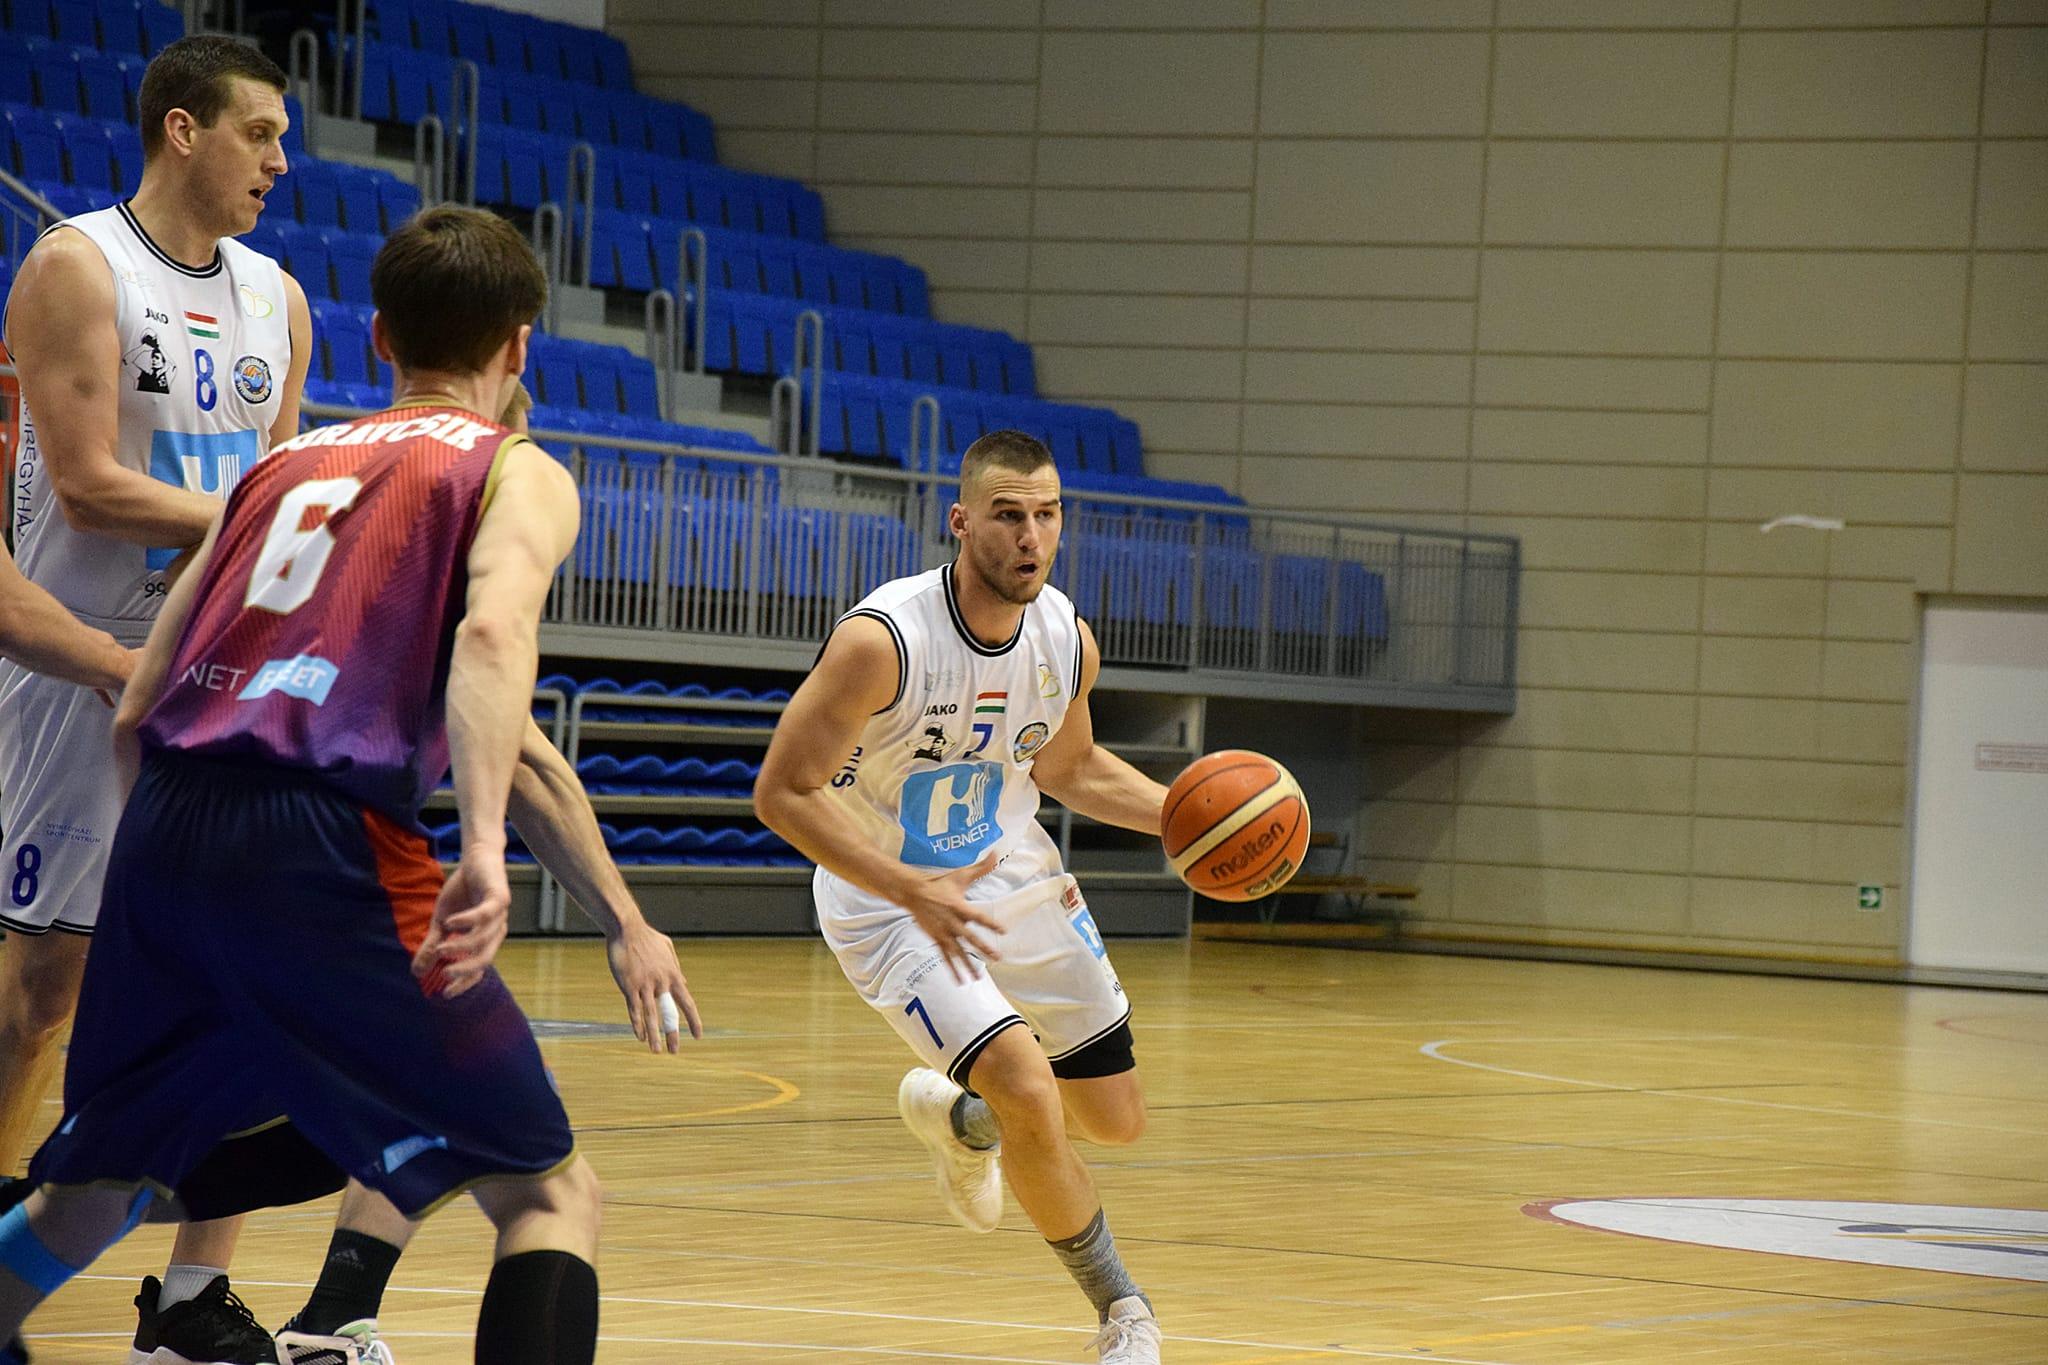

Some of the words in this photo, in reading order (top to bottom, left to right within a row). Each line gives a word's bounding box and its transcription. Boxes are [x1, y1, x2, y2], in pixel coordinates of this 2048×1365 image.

[194, 348, 217, 411] 8
[243, 476, 363, 616] 6
[924, 703, 959, 716] JAKO
[961, 723, 994, 760] 7
[11, 843, 42, 907] 8
[1210, 820, 1286, 882] molten
